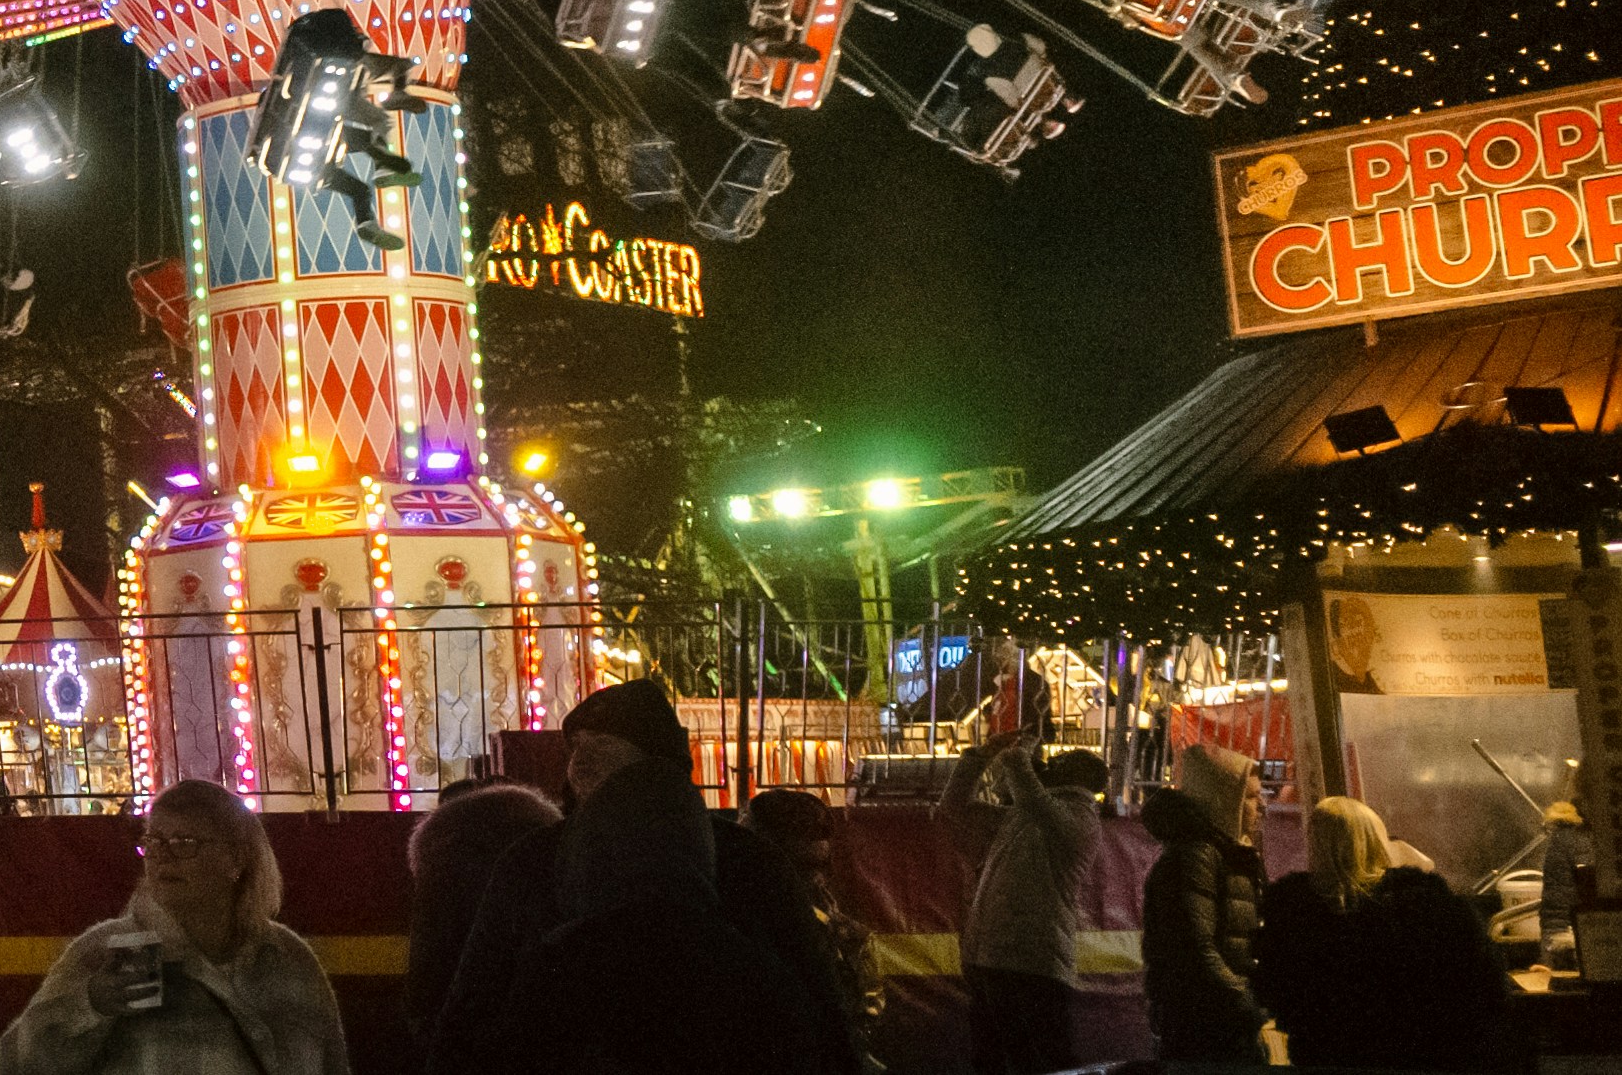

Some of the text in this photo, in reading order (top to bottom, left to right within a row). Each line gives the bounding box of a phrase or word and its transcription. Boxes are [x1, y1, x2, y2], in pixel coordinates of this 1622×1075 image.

[1238, 170, 1309, 216] CHURROS
[1440, 627, 1540, 642] Box of Churros
[1414, 671, 1545, 686] Churros with nutella
